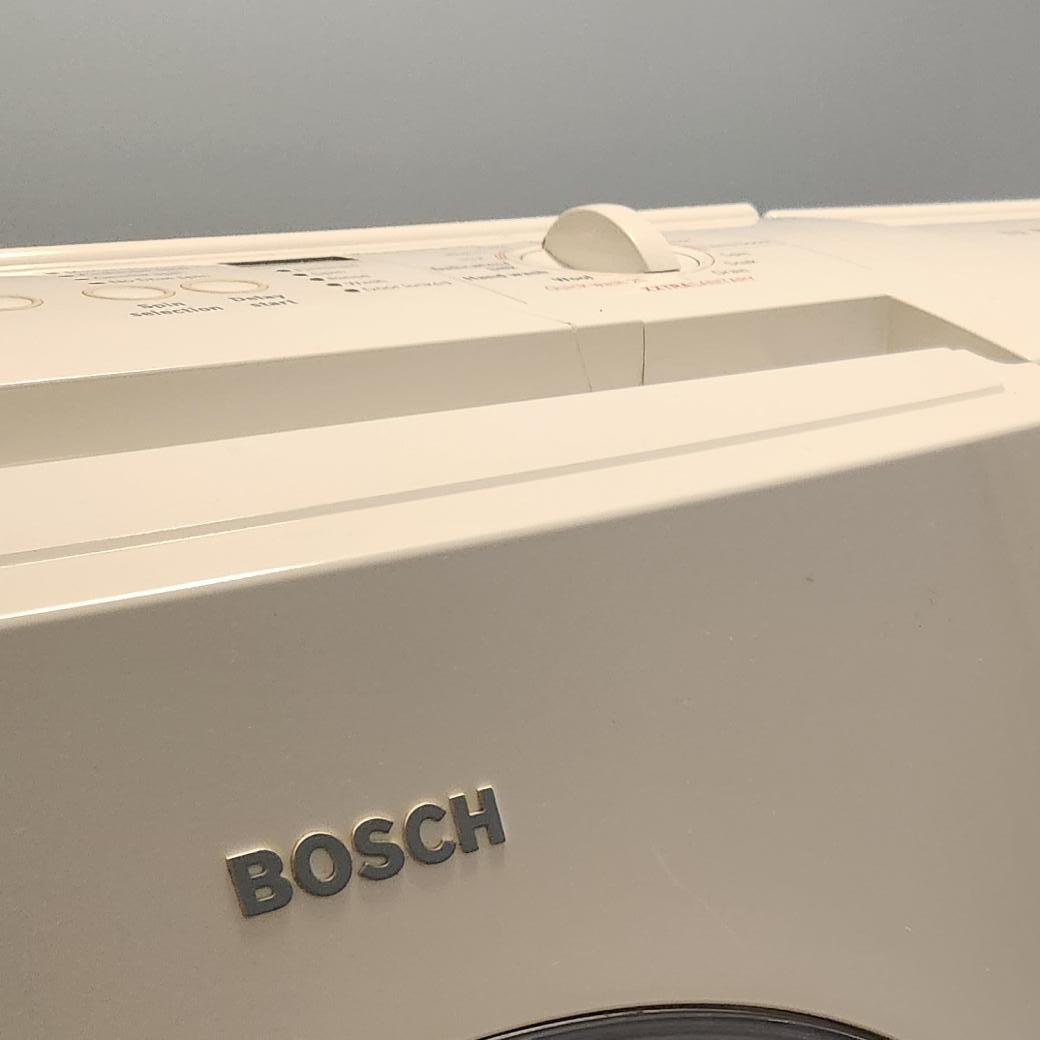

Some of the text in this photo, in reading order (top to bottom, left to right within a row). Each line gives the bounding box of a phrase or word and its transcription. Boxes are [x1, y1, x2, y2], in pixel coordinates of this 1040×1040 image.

[136, 301, 186, 309] Spin
[250, 299, 299, 308] start
[129, 306, 225, 317] selection
[225, 784, 506, 919] BOSCH
